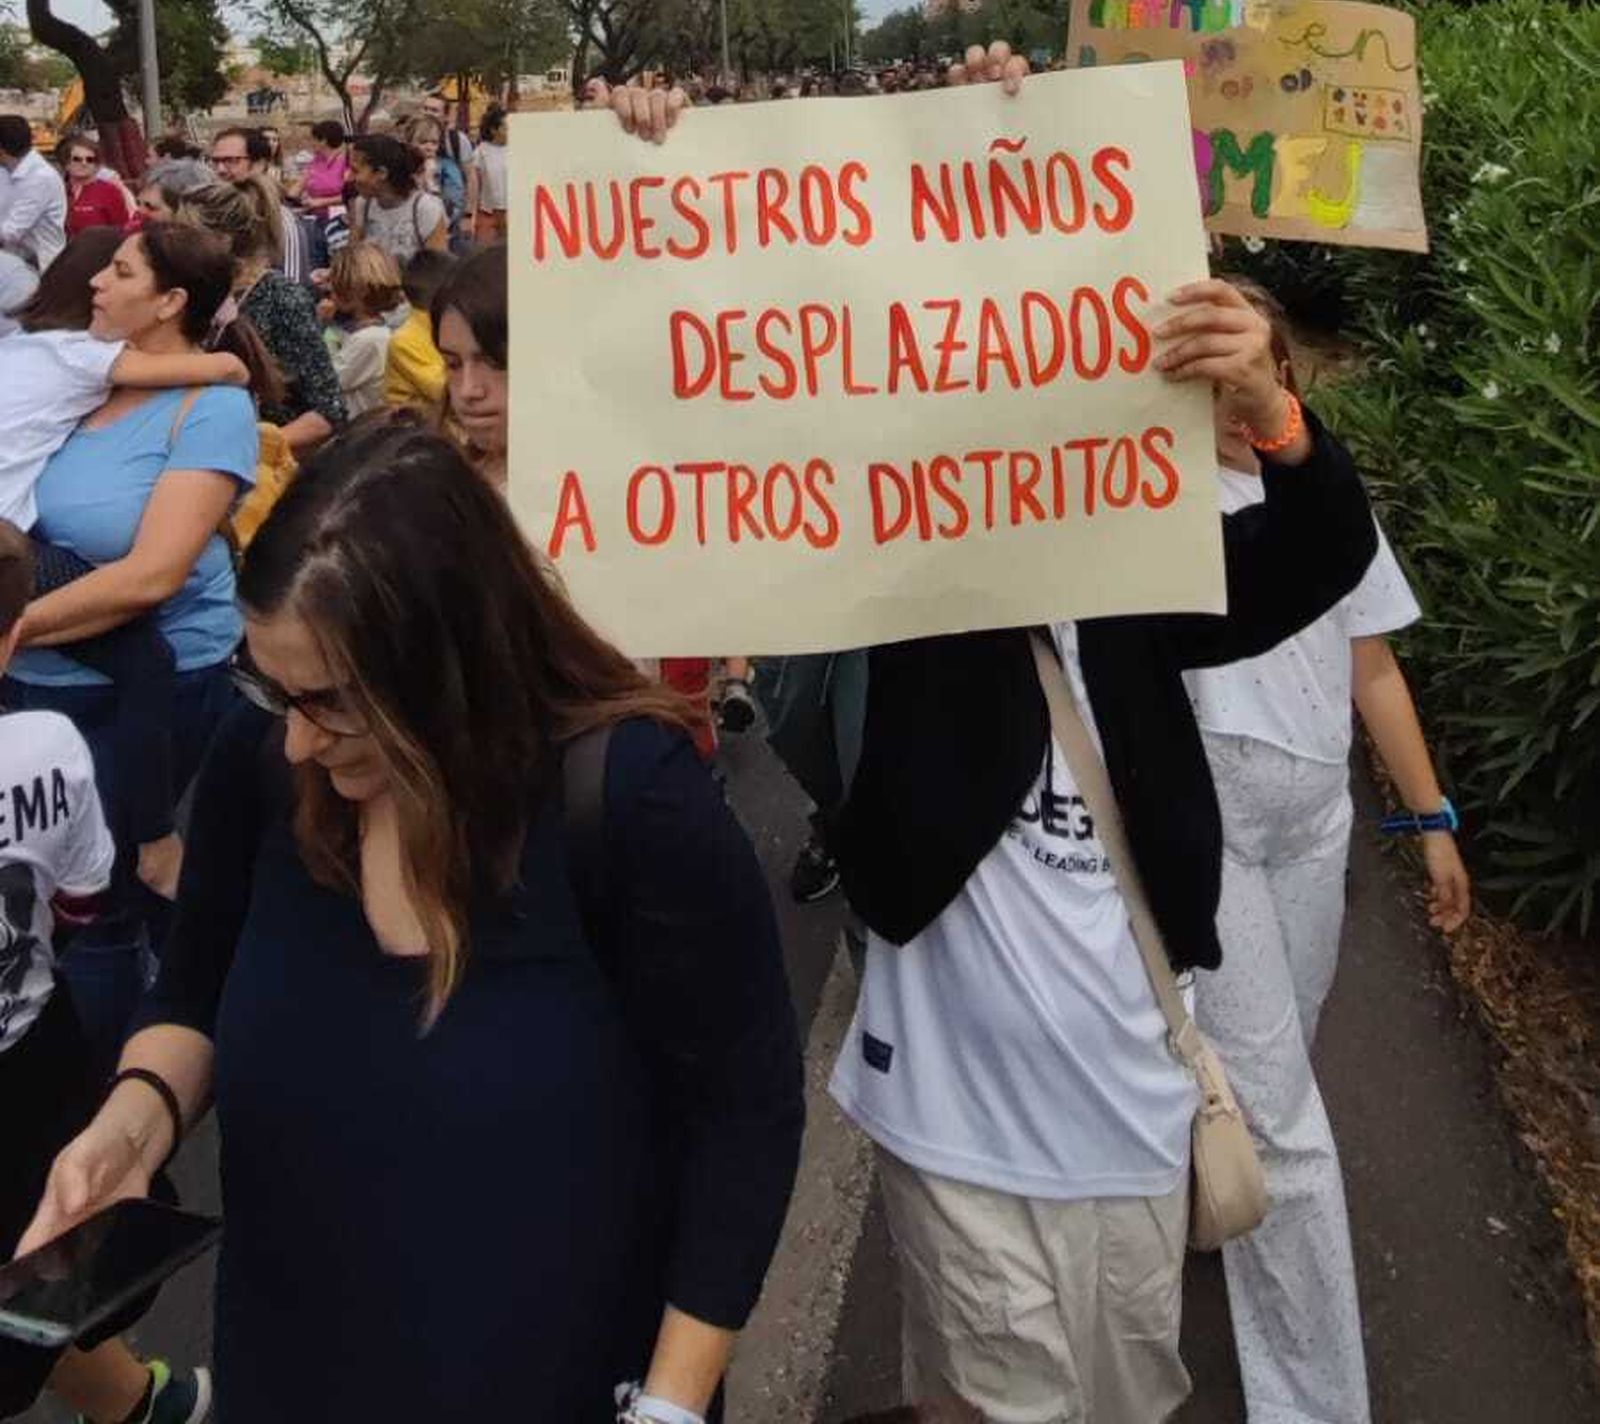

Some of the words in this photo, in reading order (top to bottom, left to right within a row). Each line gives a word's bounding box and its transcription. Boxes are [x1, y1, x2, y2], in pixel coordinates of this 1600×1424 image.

[534, 161, 873, 261] NUESTROS
[911, 137, 1134, 242] NIÑOS
[669, 276, 1157, 400] DESPLAZADOS
[547, 471, 597, 560] A
[626, 456, 841, 550] OTROS
[868, 426, 1180, 545] DISTRITOS
[1034, 847, 1098, 873] LEADING
